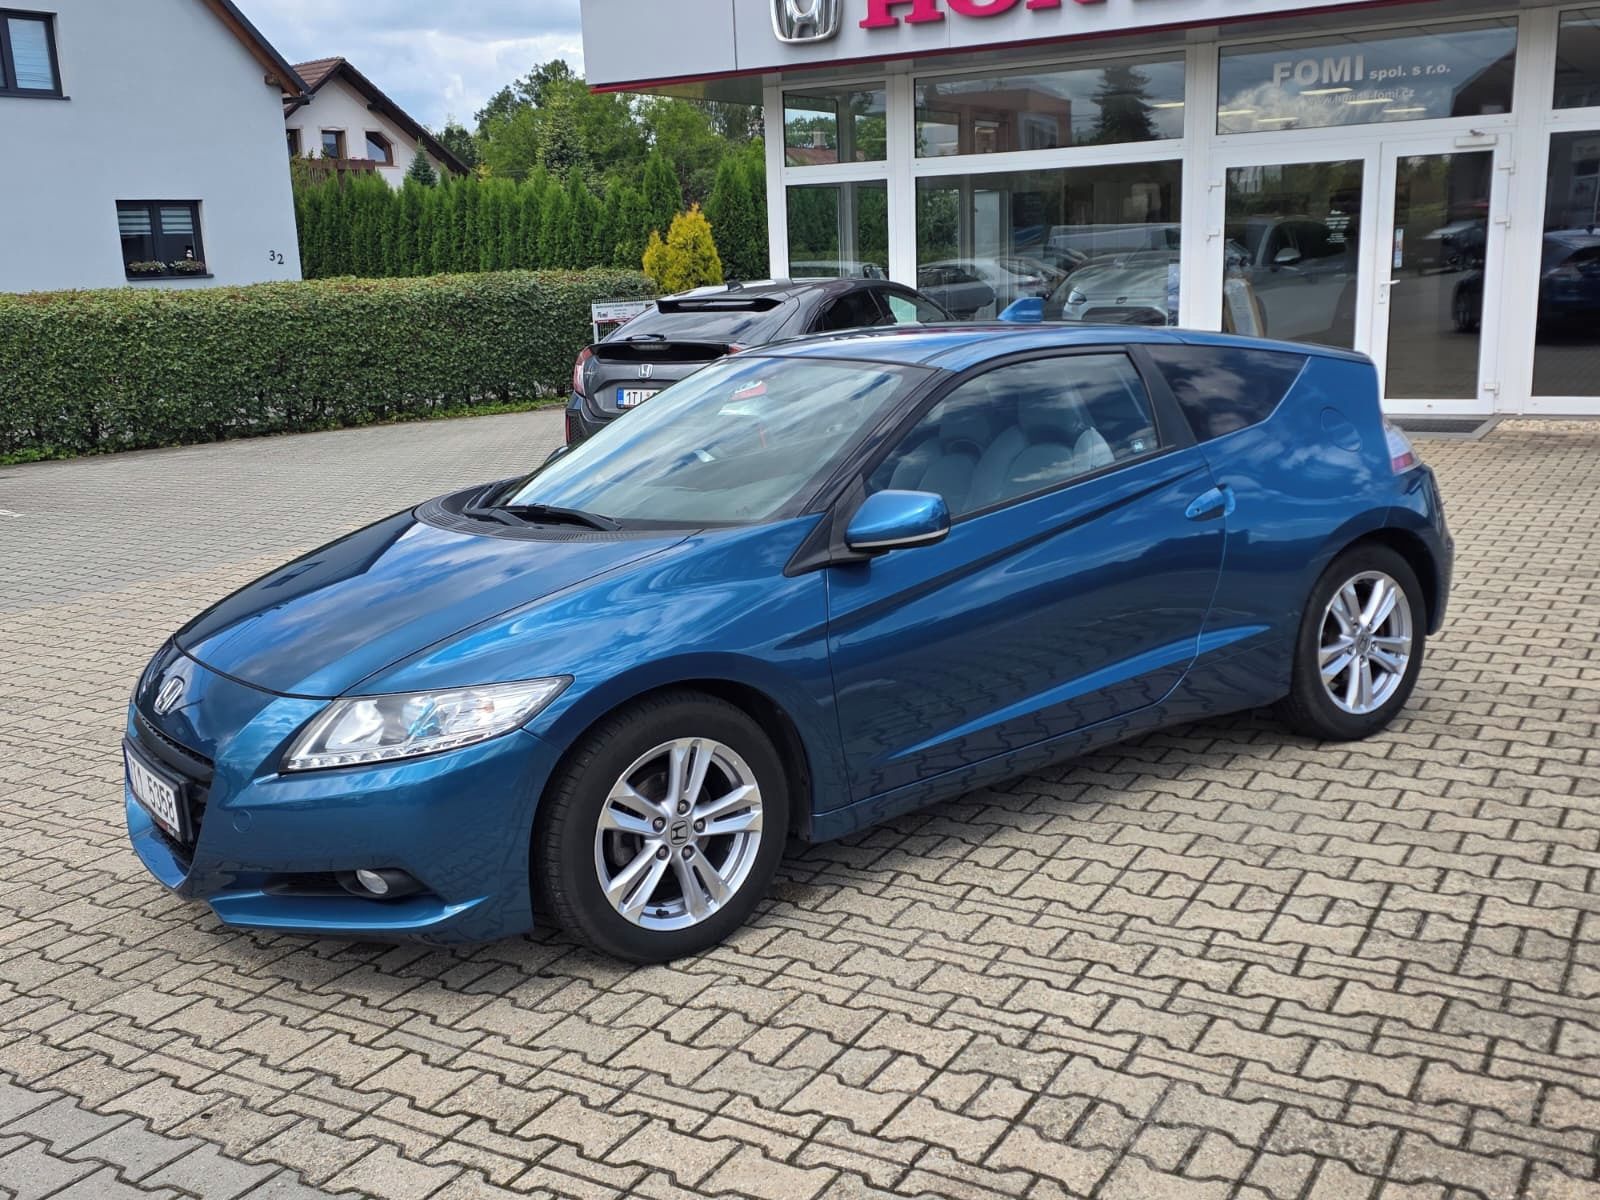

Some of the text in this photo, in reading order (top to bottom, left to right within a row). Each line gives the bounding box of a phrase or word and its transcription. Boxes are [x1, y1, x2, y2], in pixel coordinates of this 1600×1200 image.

[1273, 55, 1451, 88] FOMI spol. s r.o.
[269, 250, 284, 264] 32
